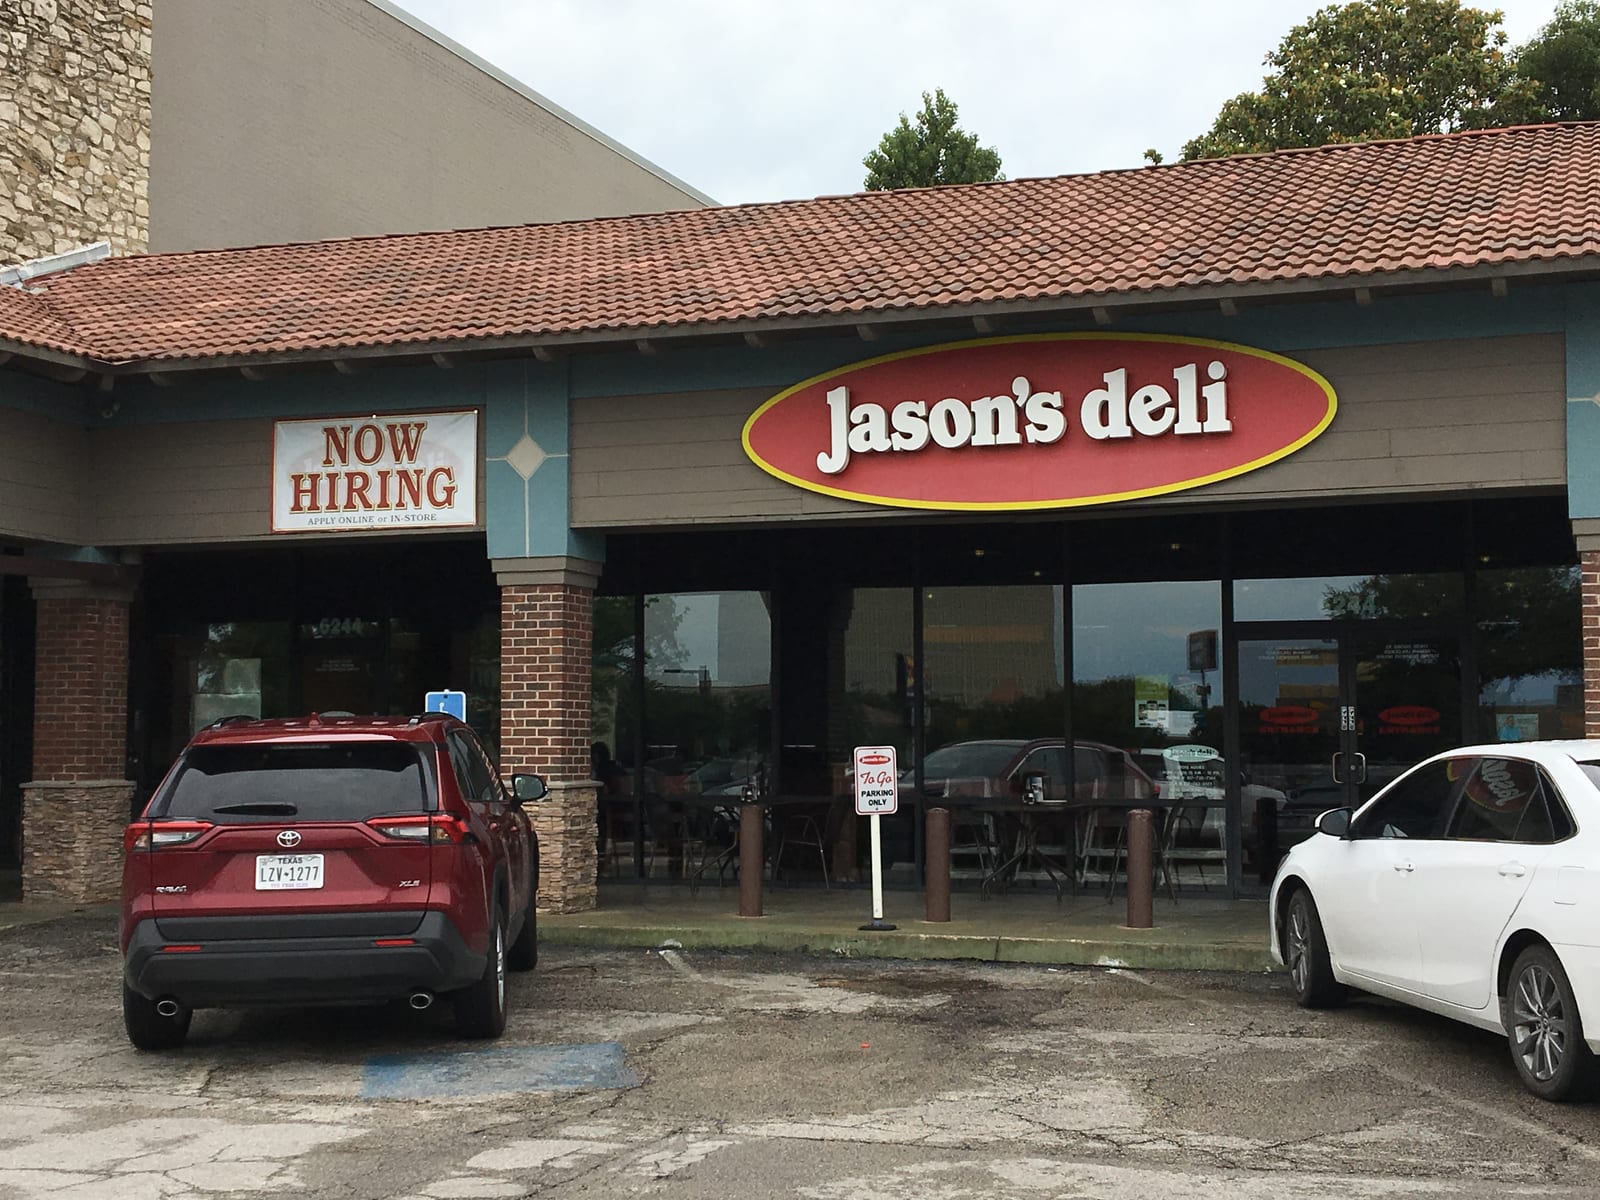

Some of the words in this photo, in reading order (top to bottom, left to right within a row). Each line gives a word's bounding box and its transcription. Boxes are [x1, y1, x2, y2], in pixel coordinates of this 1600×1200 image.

[816, 376, 1067, 474] Jason's
[1080, 361, 1233, 440] deli
[322, 421, 427, 467] NOW
[289, 466, 458, 513] HIRING
[308, 516, 336, 526] APPLY
[338, 515, 375, 525] ONLINE
[391, 513, 437, 523] IN-STORE
[320, 617, 362, 635] 6244
[860, 771, 875, 784] To
[876, 771, 893, 787] Go
[861, 789, 894, 798] PARKING
